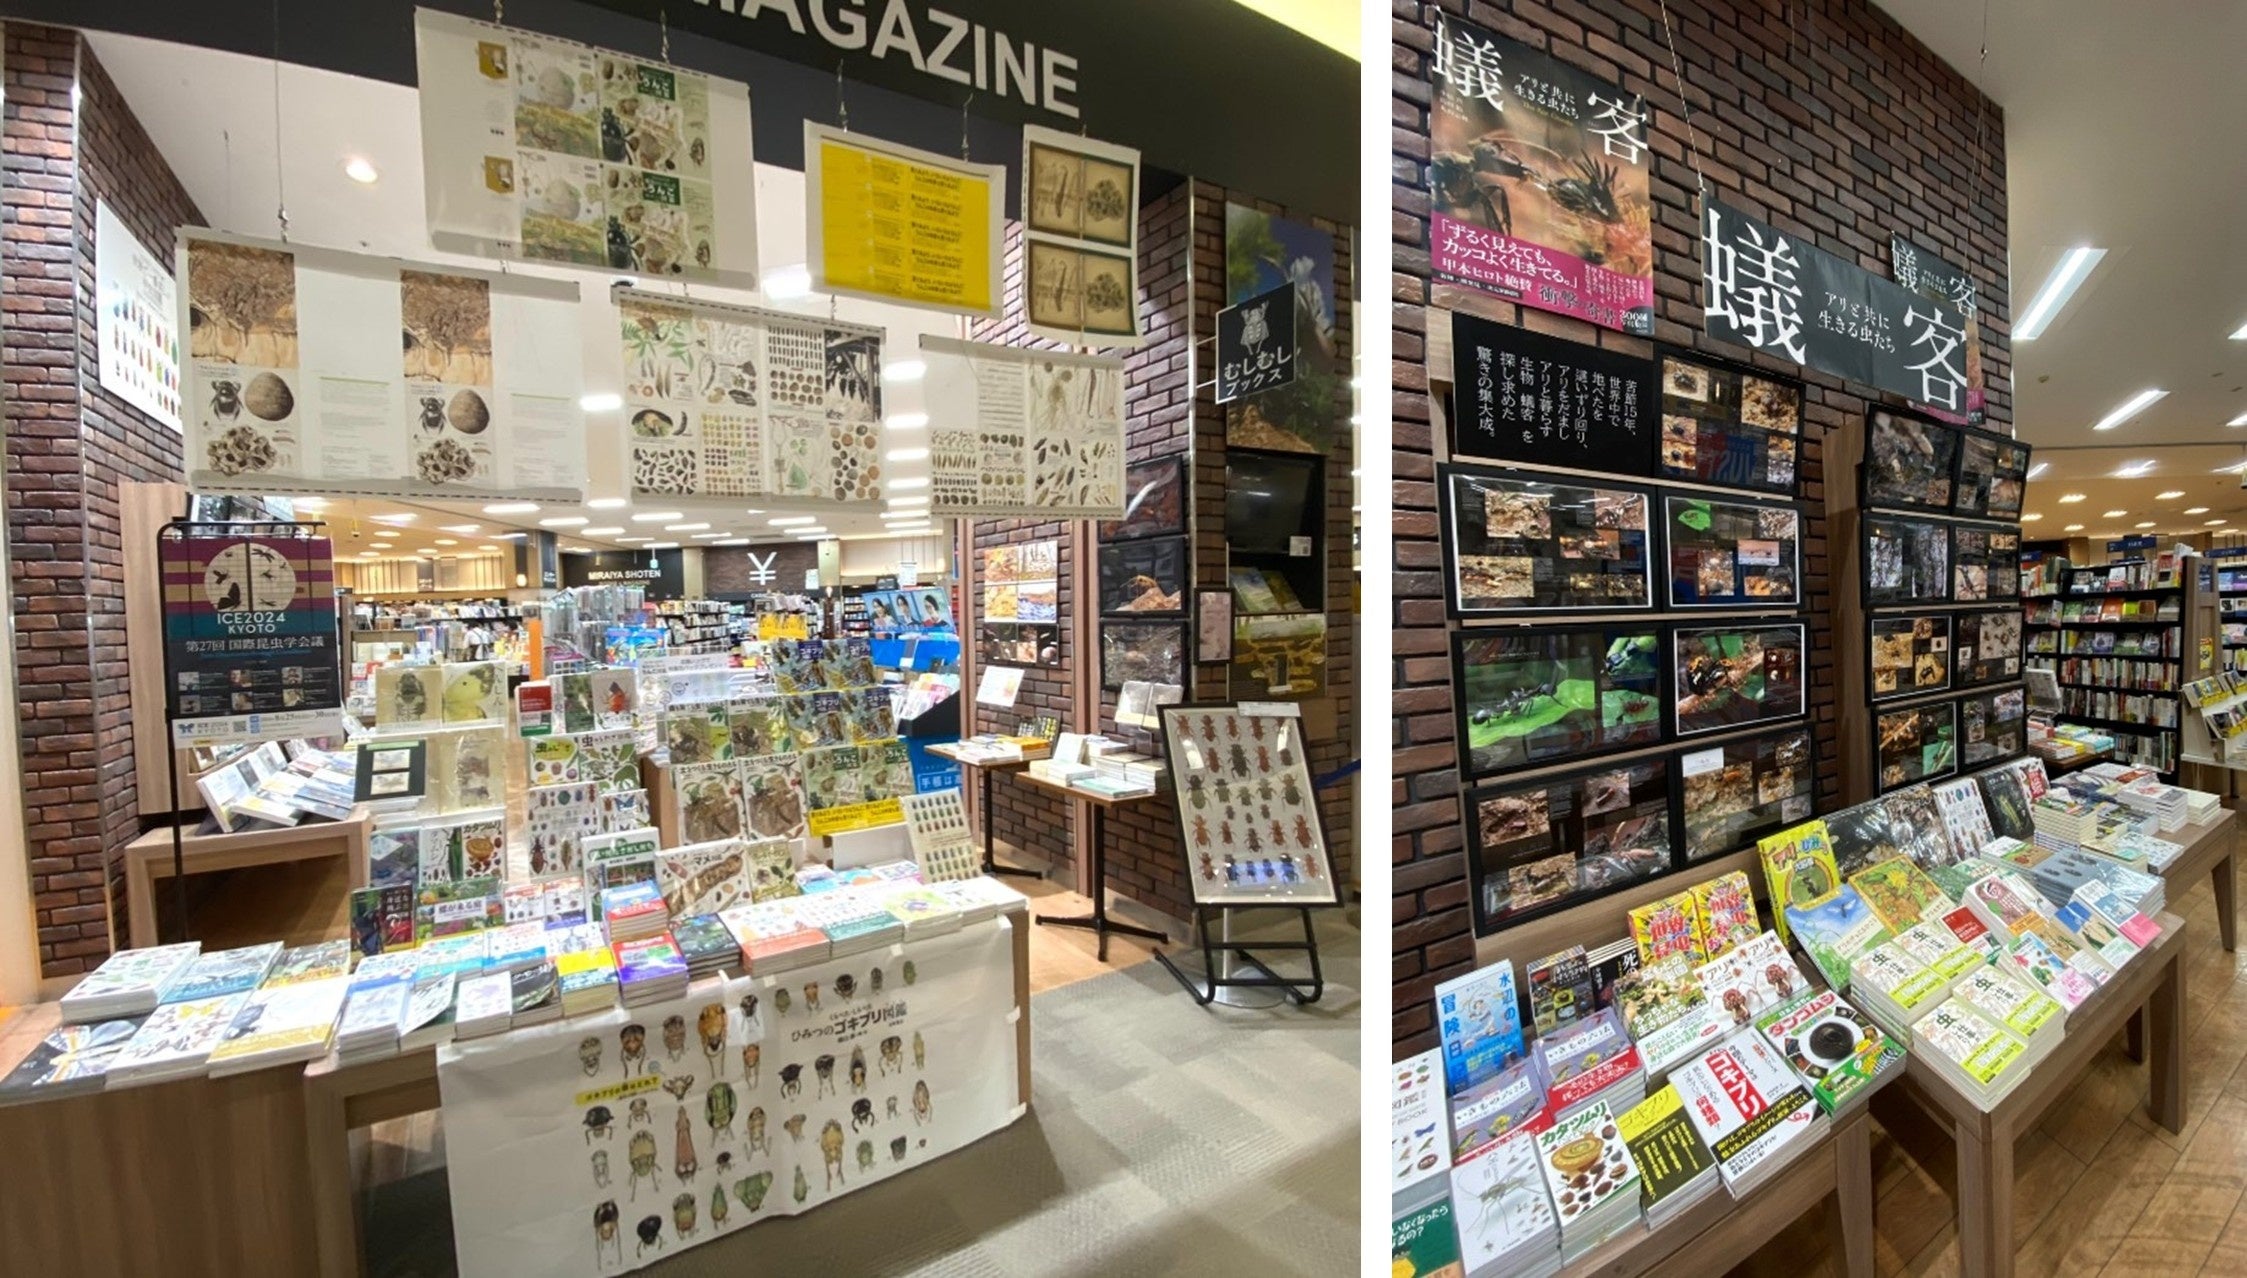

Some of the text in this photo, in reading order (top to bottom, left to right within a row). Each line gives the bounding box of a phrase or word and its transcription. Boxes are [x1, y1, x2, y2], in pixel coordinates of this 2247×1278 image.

[693, 0, 1081, 119] GAZINE
[1432, 20, 1649, 165] 蟻 客
[1513, 83, 1580, 120] 生きる虫たち
[1519, 73, 1576, 105] アリと共に
[1441, 218, 1552, 267] 「ずるく見えても、
[1442, 238, 1578, 289] カッコよく生きてる。」
[1891, 239, 1977, 319] 蟻 客
[1702, 207, 1968, 411] 蟻 客
[1817, 310, 1896, 354] 生きる虫たち
[1824, 291, 1891, 330] アリと共に
[1224, 346, 1292, 381] むしむし
[1499, 351, 1517, 421] 探し求めた
[1476, 345, 1495, 438] 驚きの集大成。
[1520, 356, 1535, 444] 生物 蟻客 を
[1539, 360, 1553, 437] アリと暮らす
[1558, 364, 1571, 440] アリをだまし
[1574, 368, 1589, 449] 這いずり回り、
[1591, 371, 1606, 421] 地べたを
[1609, 375, 1621, 427] 世界中で
[1624, 378, 1638, 436] 苦節15年、
[588, 569, 662, 580] MIRAIYA SHOTEN
[747, 551, 778, 585] ¥
[216, 612, 286, 625] ICE2024
[227, 623, 276, 634] KYOTO
[185, 635, 325, 653] 第27回 国際昆虫学会議
[1498, 971, 1516, 1021] 水辺の
[1768, 992, 1836, 1037] ダンゴムシ
[791, 1002, 908, 1042] ひみつのゴキブリ図鑑
[1709, 1051, 1761, 1120] ゴキブリ
[1541, 1102, 1607, 1148] カタツムリ
